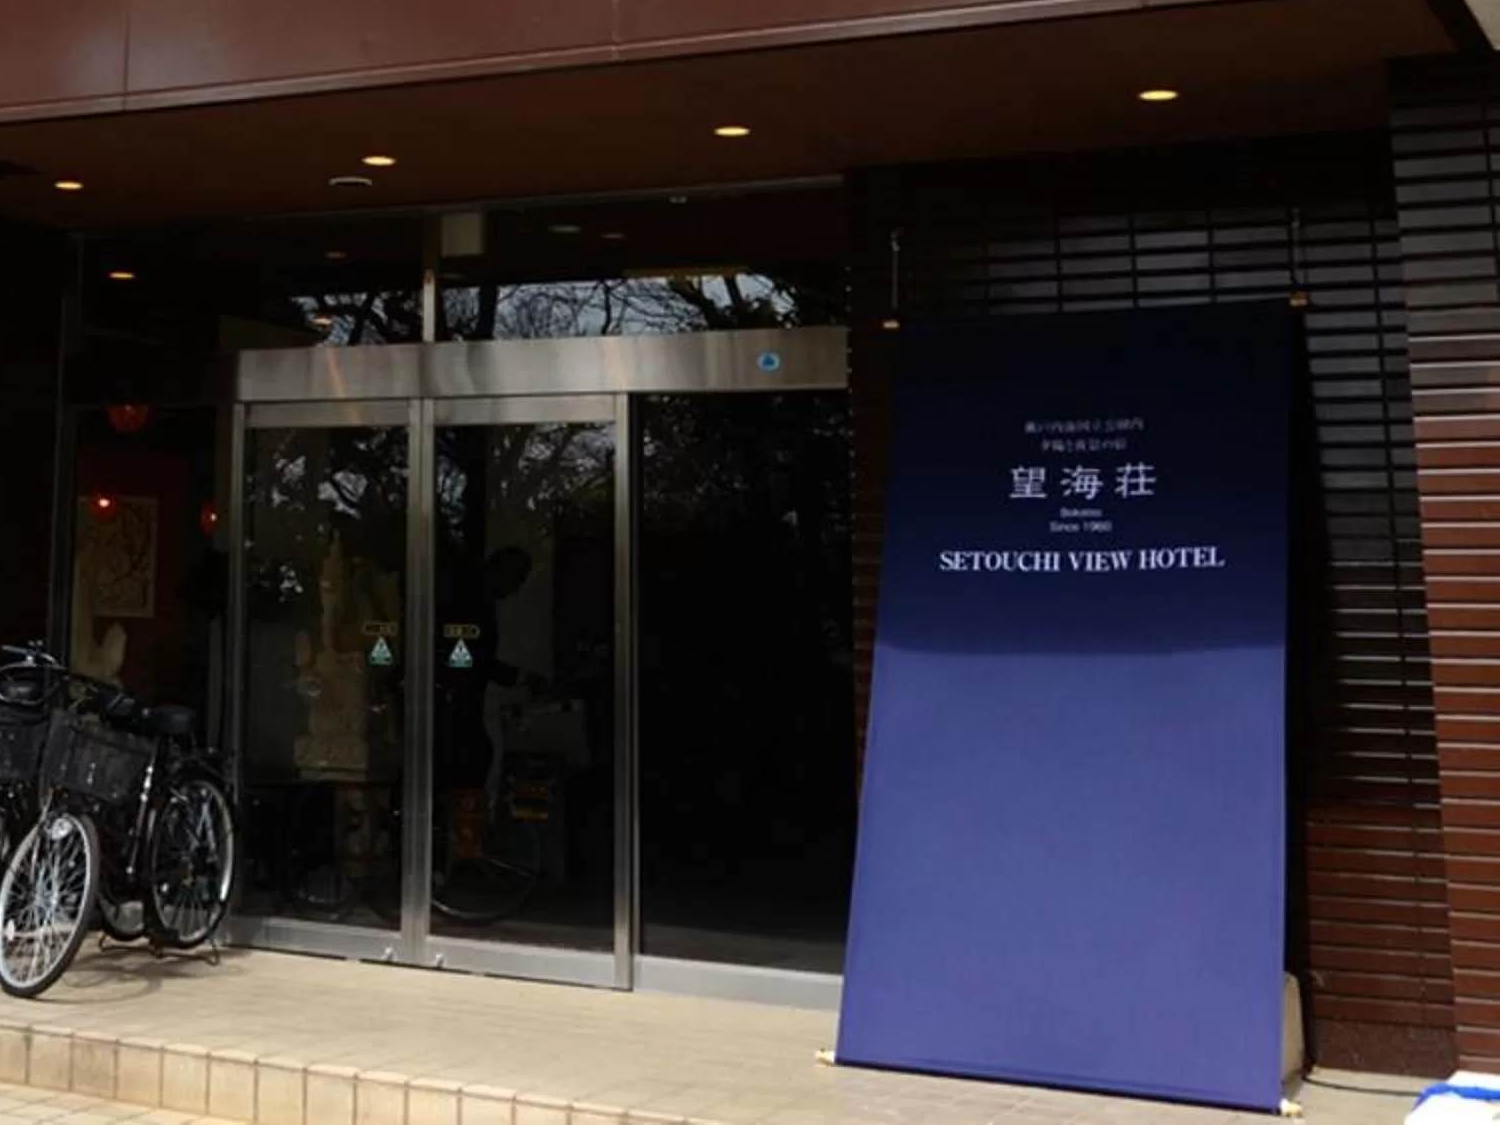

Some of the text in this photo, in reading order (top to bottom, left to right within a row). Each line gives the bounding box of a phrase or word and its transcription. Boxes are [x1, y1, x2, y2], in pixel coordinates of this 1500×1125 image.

[1009, 462, 1156, 500] 望海荘
[940, 546, 1226, 572] SETOUCHI VIEW HOTEL
